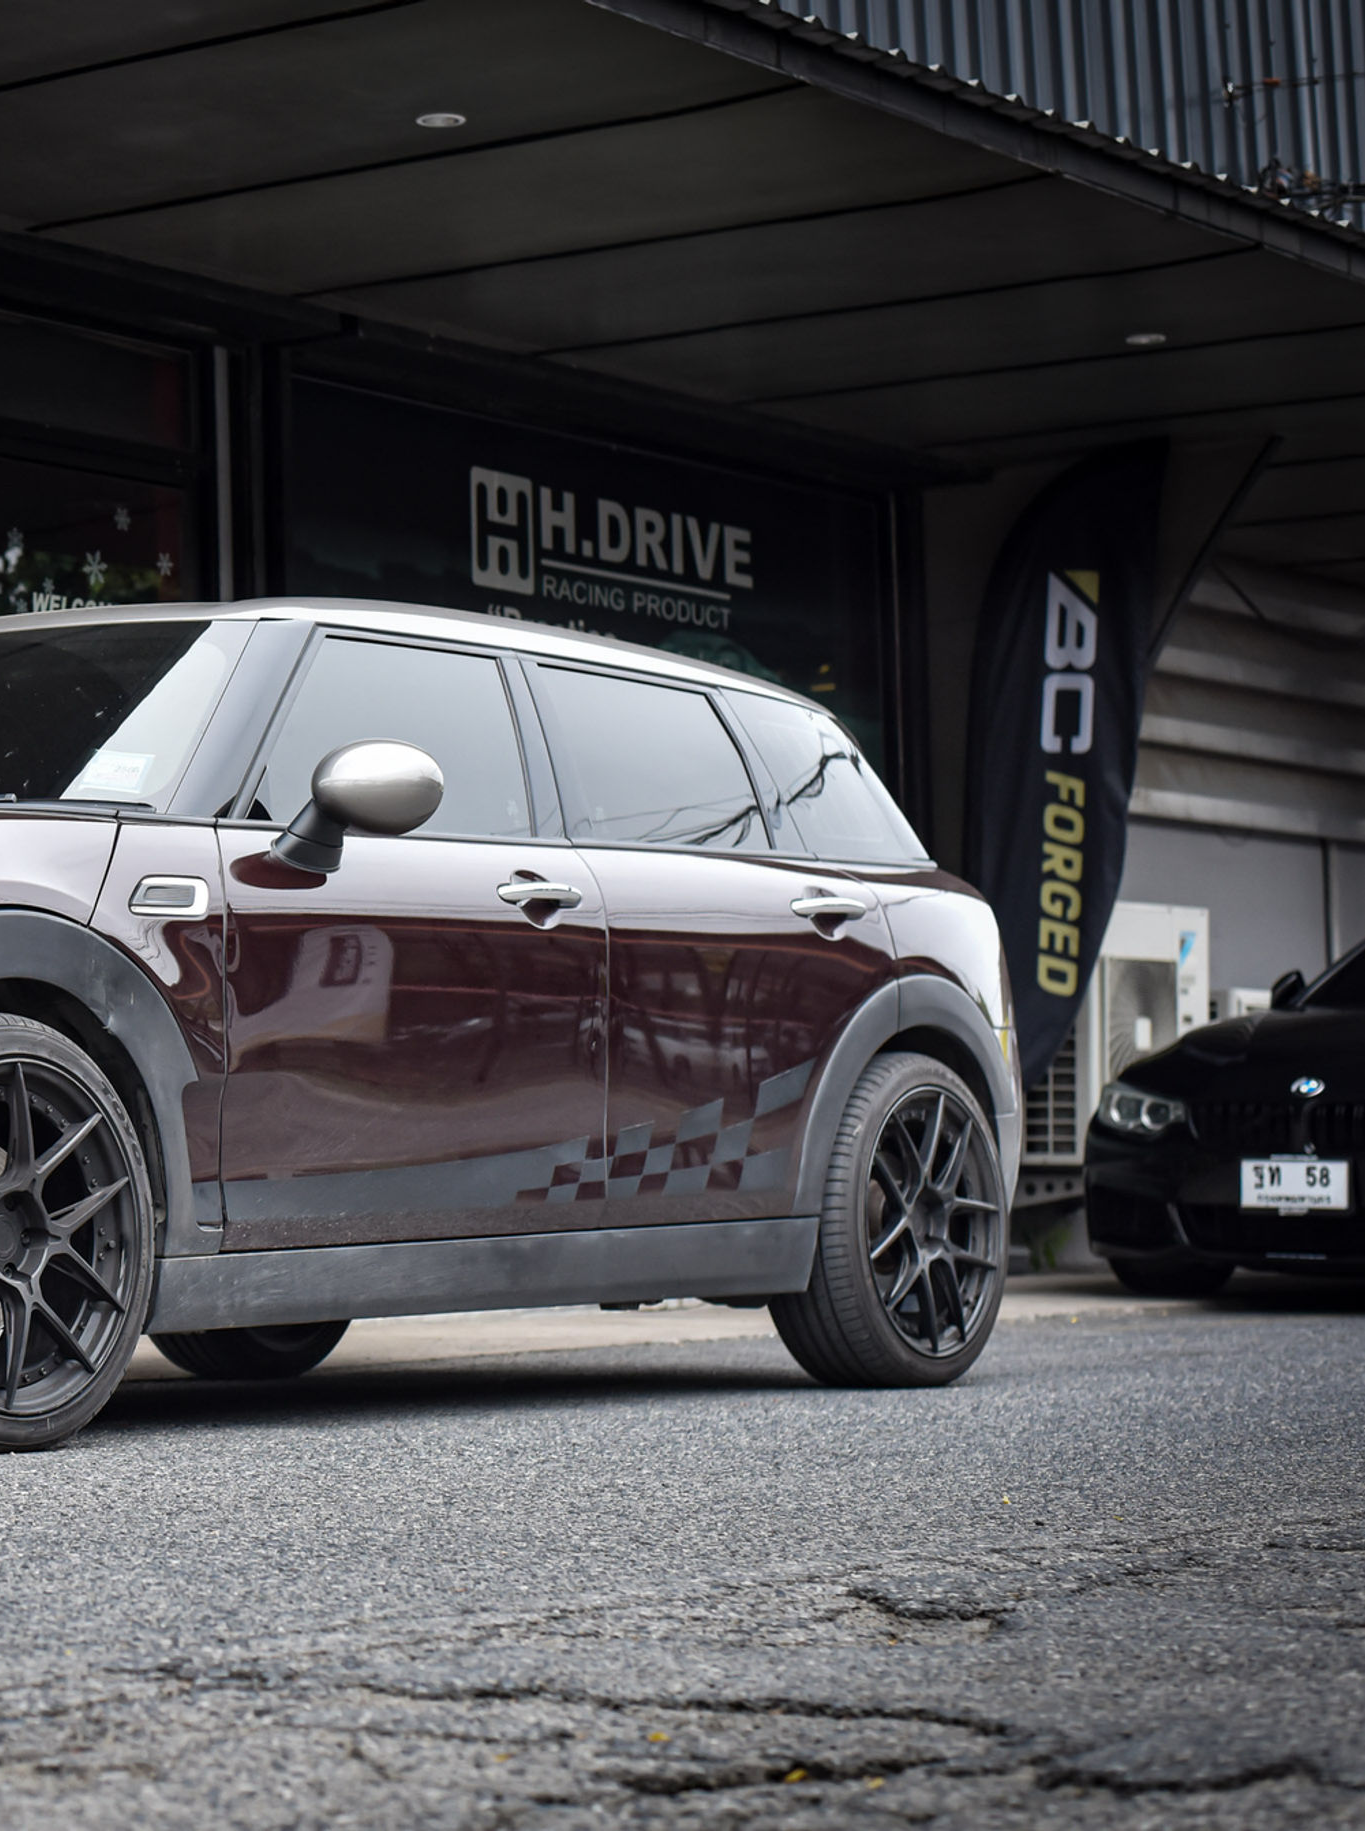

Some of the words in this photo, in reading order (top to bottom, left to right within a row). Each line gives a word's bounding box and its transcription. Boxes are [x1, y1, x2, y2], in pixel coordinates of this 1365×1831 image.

[540, 486, 754, 588] H.DRIVE
[542, 575, 625, 611] RACING
[633, 592, 732, 630] PRODUCT
[1040, 571, 1099, 754] BC
[1036, 769, 1086, 999] FORGED
[1305, 1165, 1331, 1188] 58
